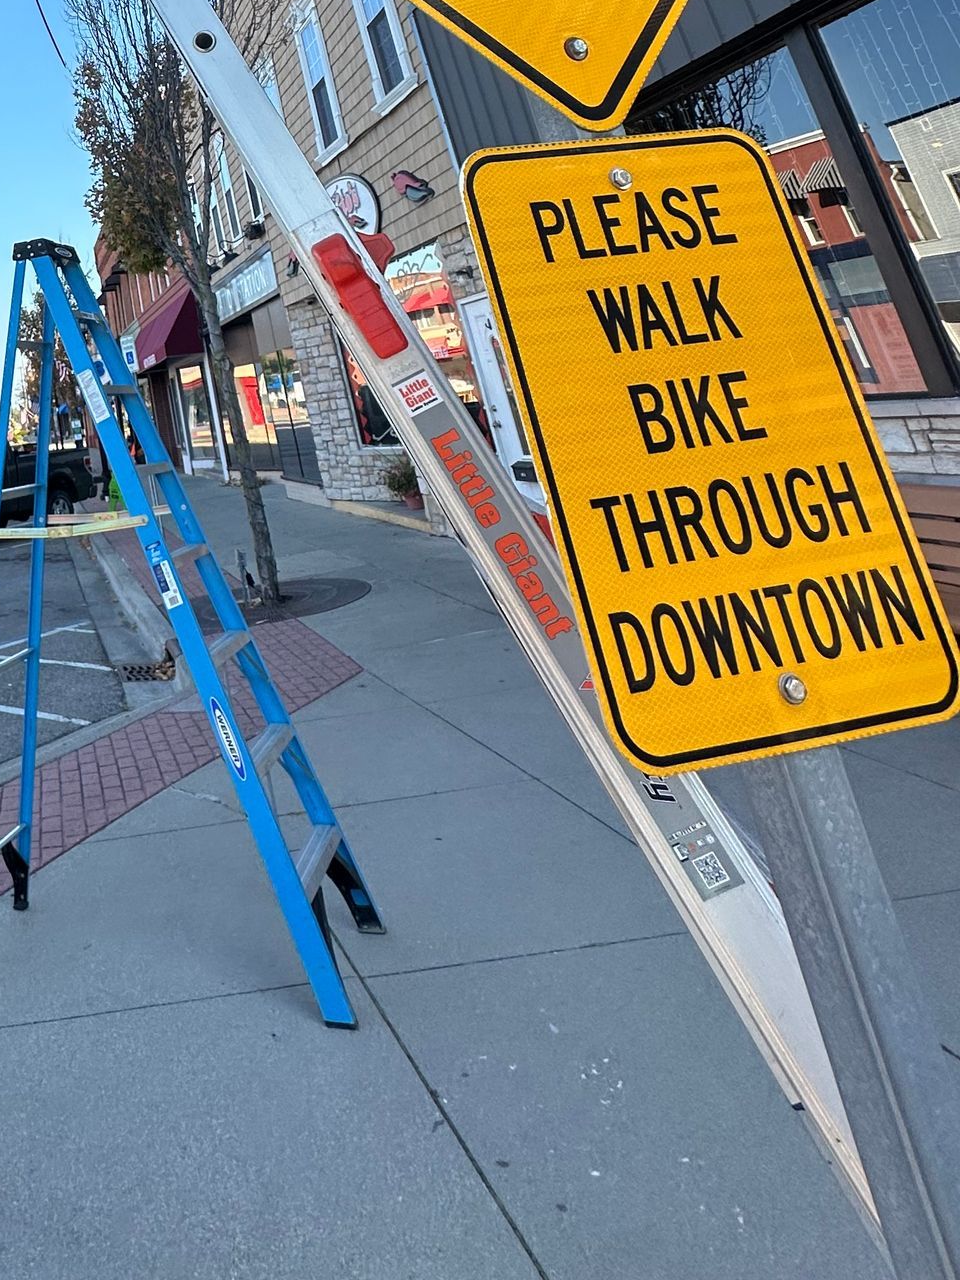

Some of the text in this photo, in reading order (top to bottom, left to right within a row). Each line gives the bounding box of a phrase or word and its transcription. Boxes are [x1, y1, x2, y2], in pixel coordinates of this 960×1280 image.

[528, 184, 738, 263] PLEASE
[586, 275, 743, 354] WALK
[398, 378, 430, 399] Little
[404, 387, 436, 408] Giant
[626, 370, 768, 455] BIKE
[431, 428, 575, 641] Little Giant
[589, 461, 873, 573] THROUGH
[607, 565, 926, 694] DOWNTOWN
[216, 714, 240, 763] WERNER
